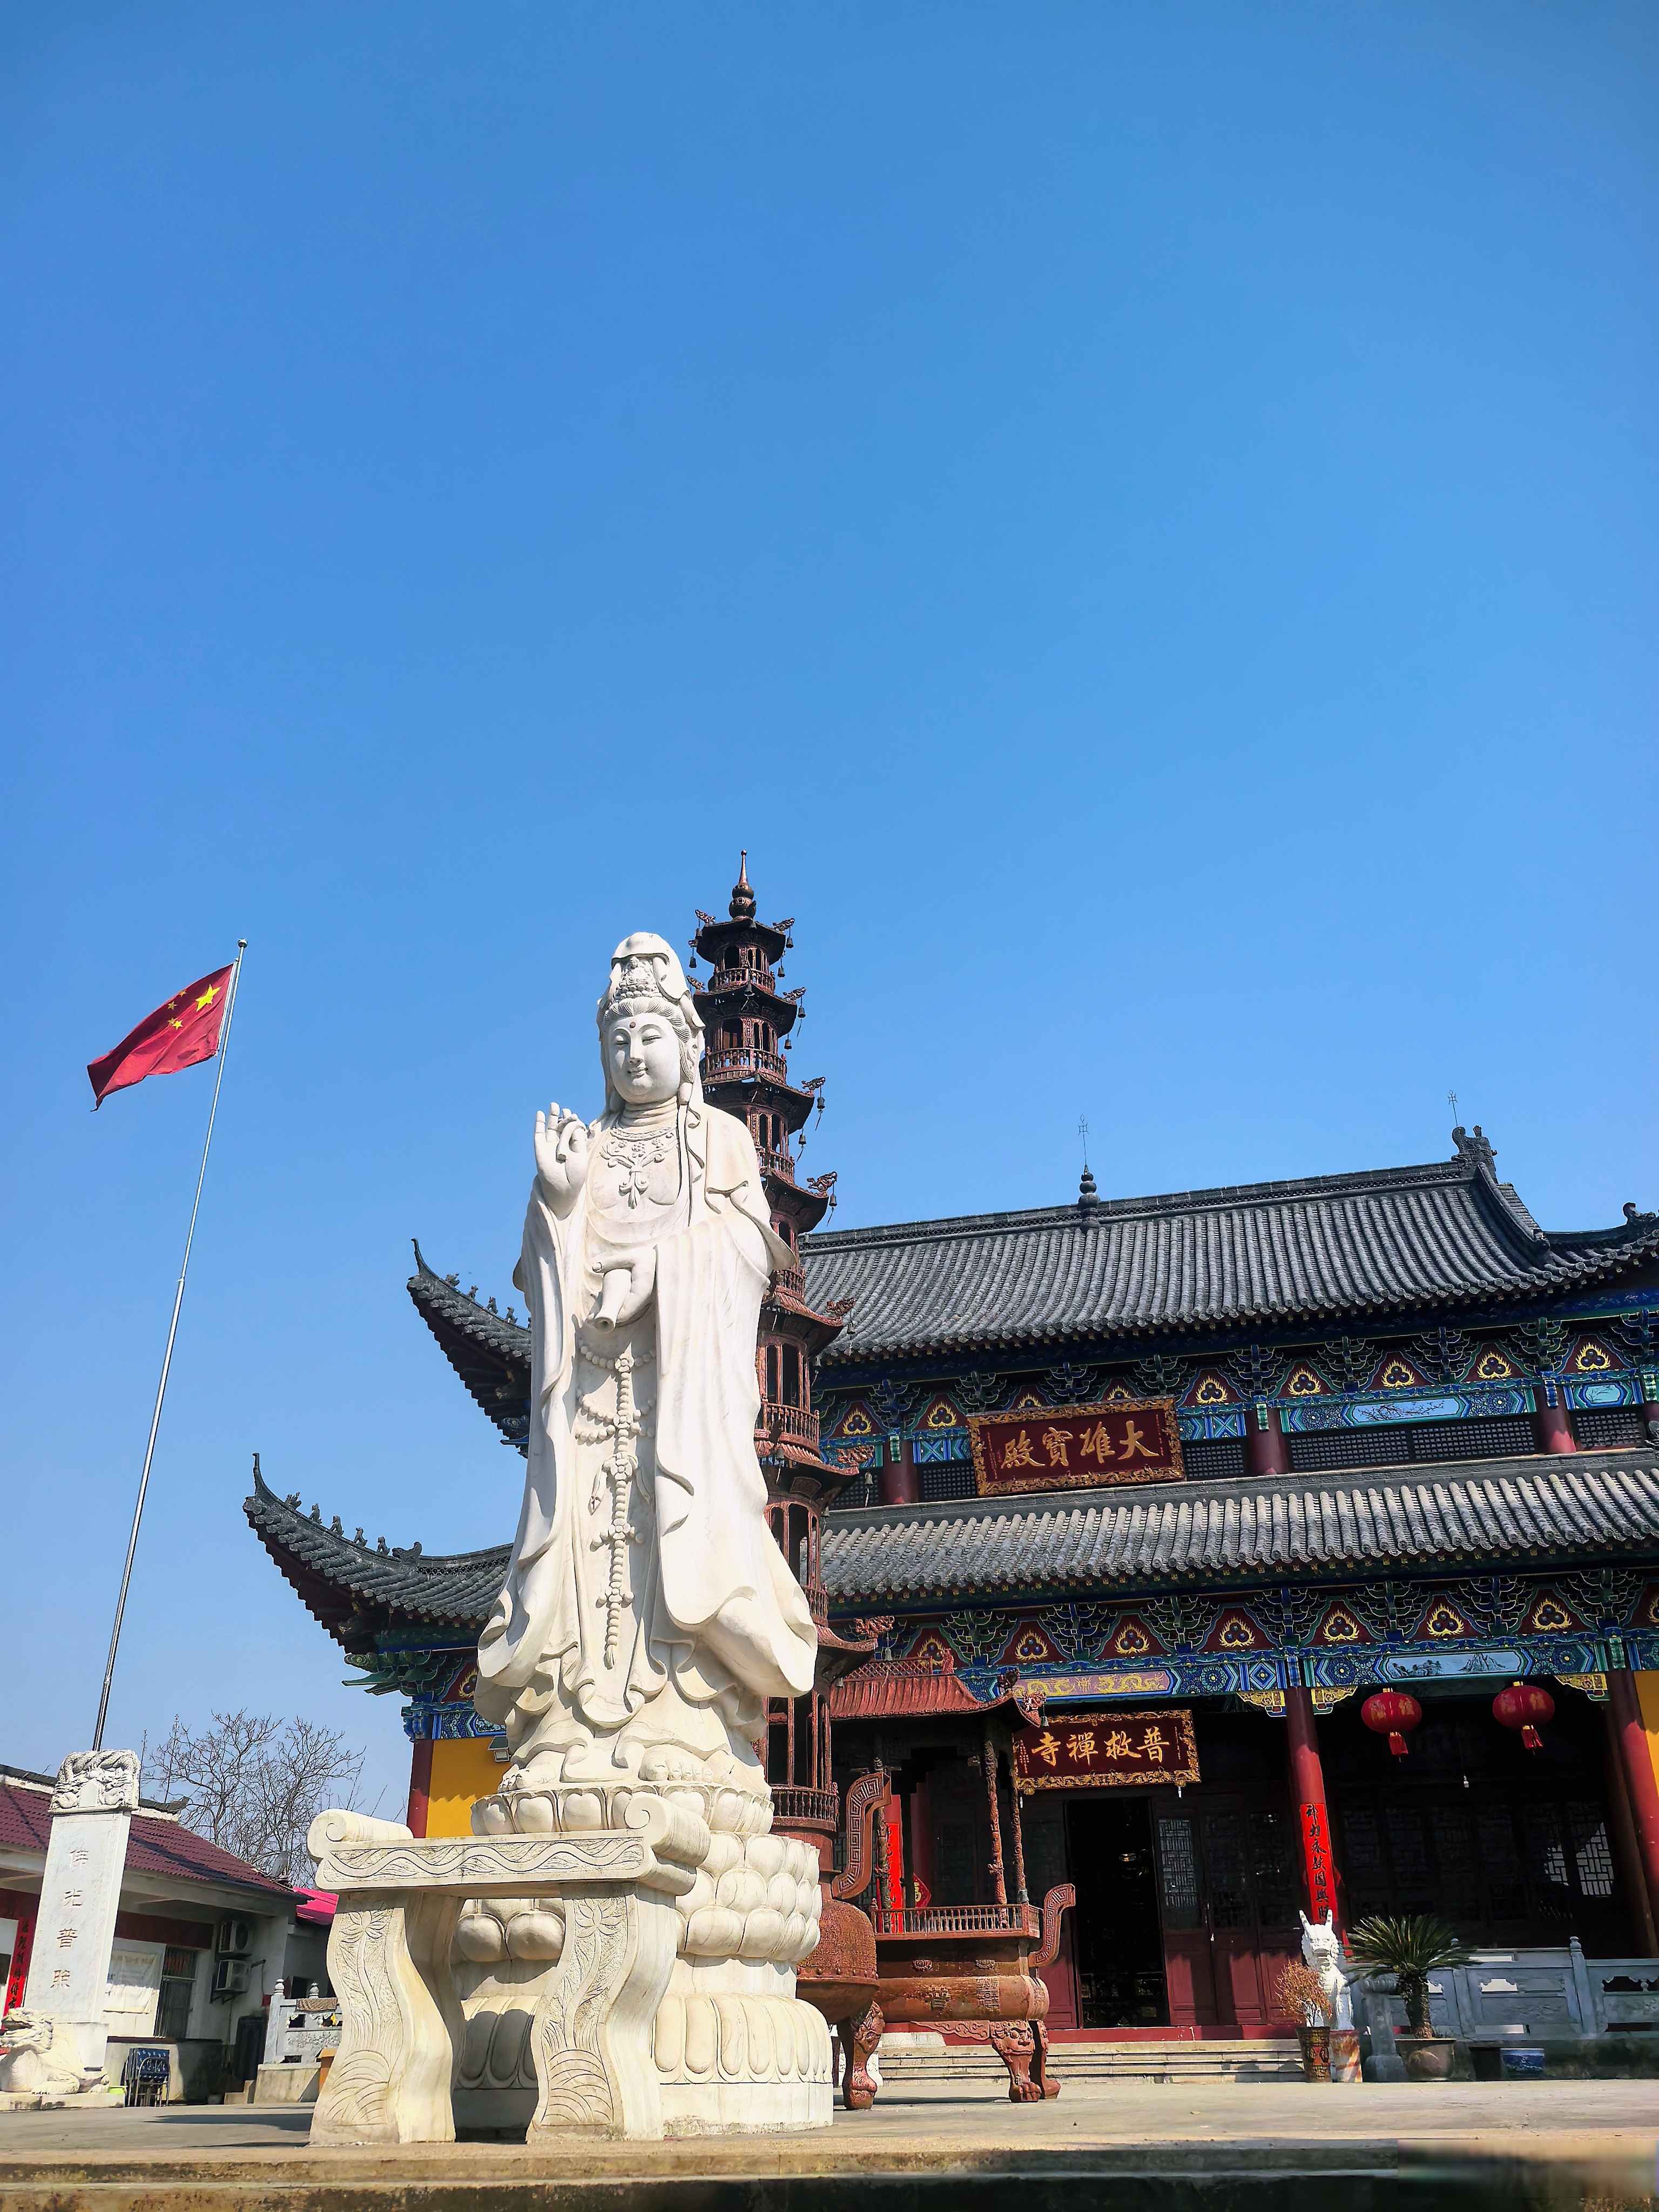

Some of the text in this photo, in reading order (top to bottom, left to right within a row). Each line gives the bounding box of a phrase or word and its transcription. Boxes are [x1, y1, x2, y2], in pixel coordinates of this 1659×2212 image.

[1000, 1420, 1160, 1469] 大雄寶殿
[1031, 1726, 1170, 1767] 普救禪寺
[50, 1848, 89, 1990] 佛光普照
